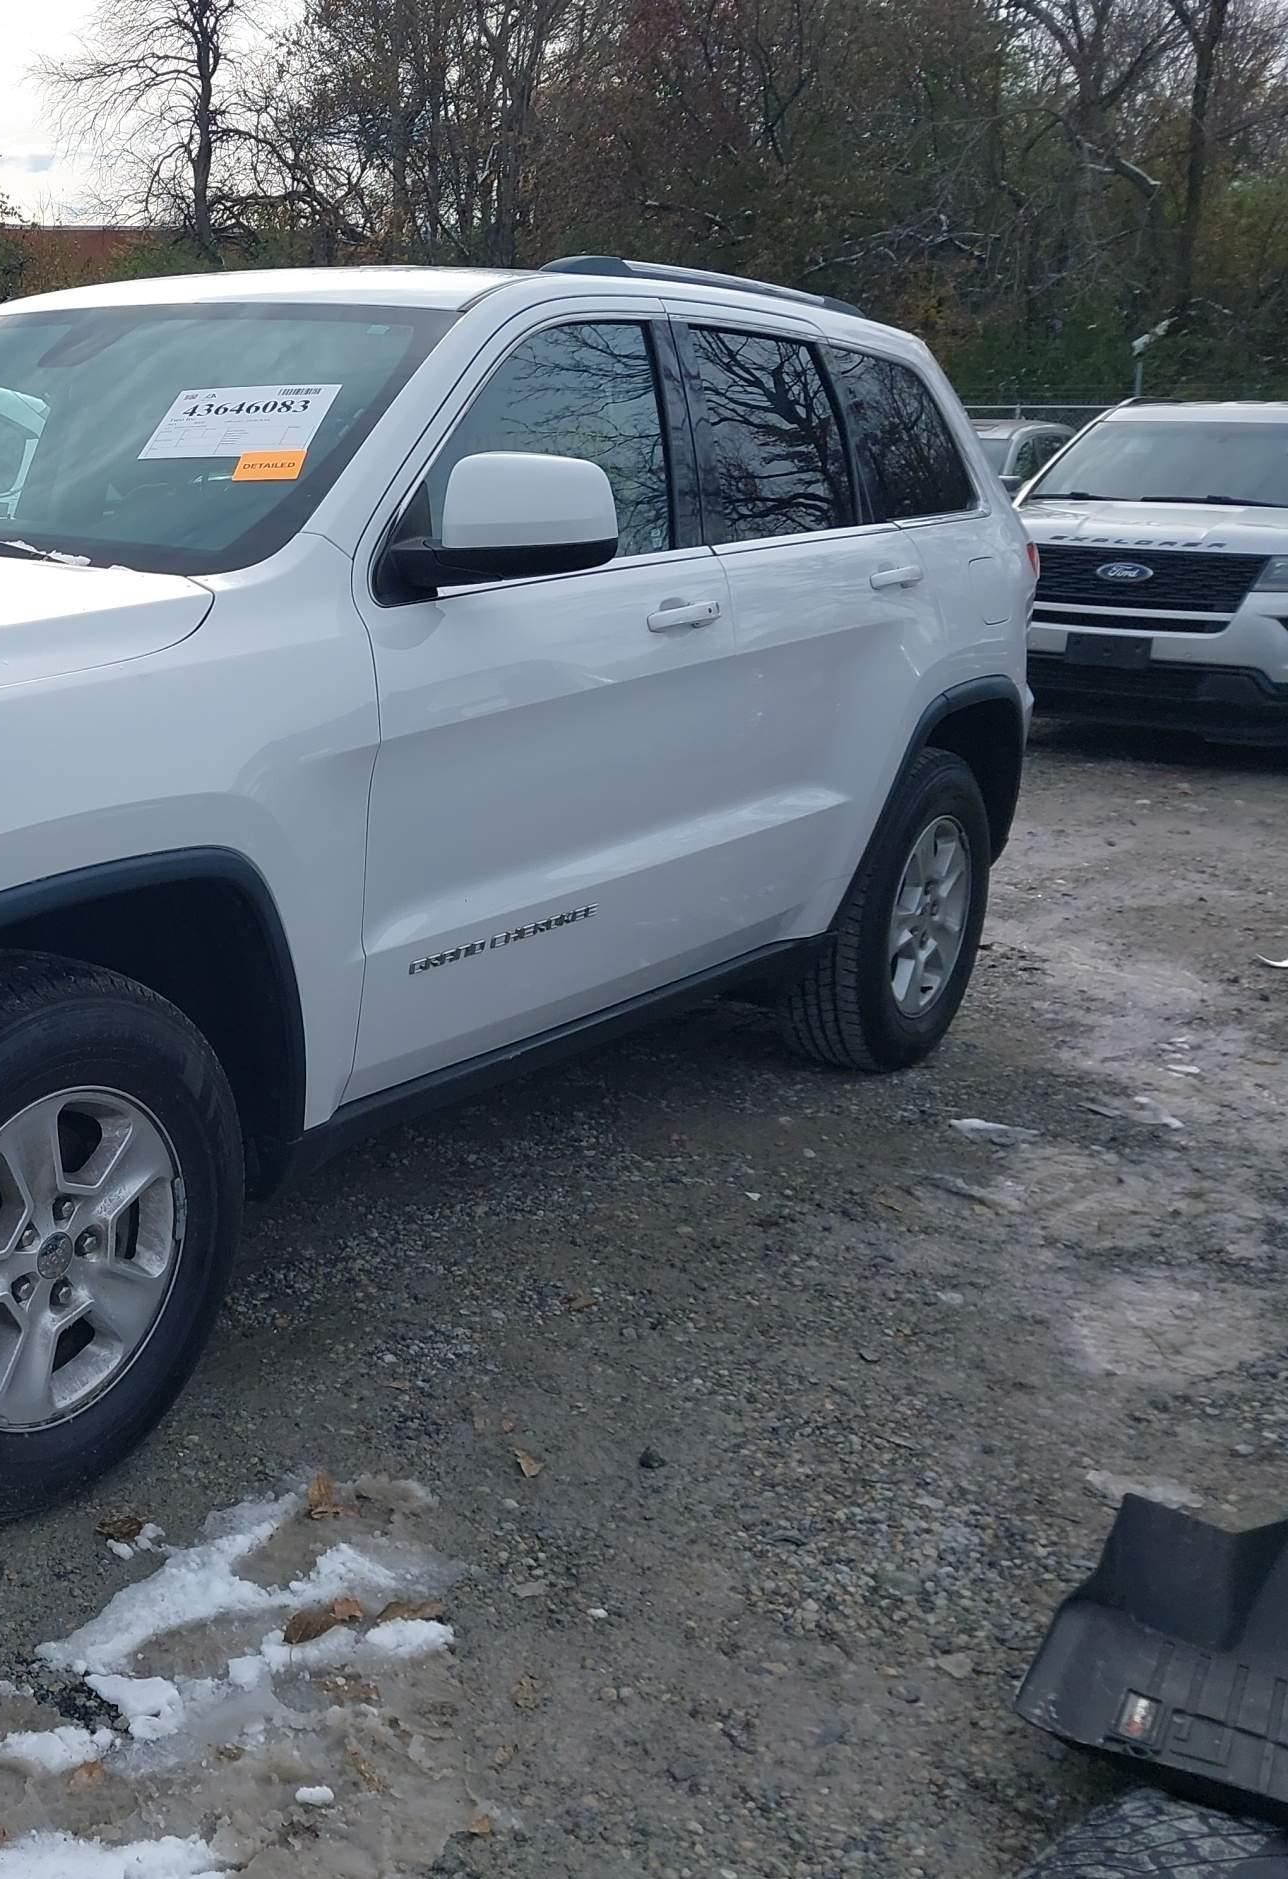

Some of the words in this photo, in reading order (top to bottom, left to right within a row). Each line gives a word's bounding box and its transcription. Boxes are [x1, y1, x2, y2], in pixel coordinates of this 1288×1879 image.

[182, 399, 311, 417] 43646083
[242, 462, 296, 470] DETAILED
[1049, 535, 1227, 548] EXPLORER
[1107, 564, 1140, 578] Ford
[408, 939, 486, 976] GRAND
[489, 902, 600, 950] CHEROKEE
